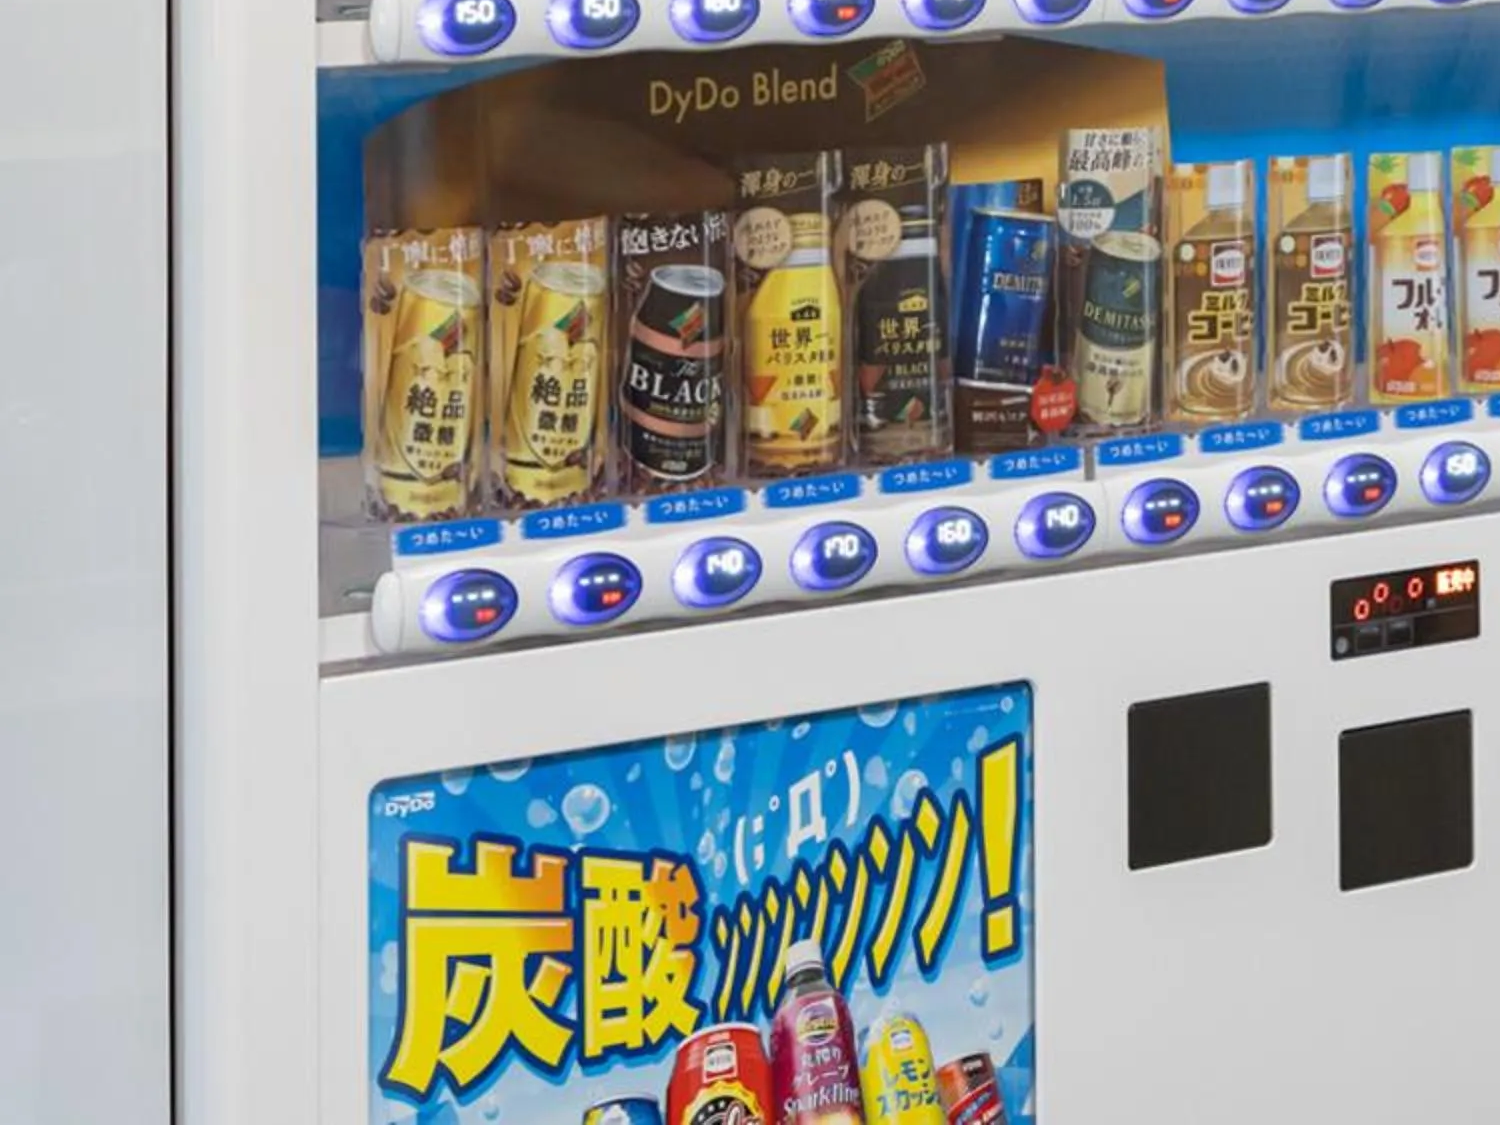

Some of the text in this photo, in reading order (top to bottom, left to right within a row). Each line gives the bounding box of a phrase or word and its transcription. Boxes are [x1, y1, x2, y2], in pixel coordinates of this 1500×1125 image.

[456, 0, 495, 24] 150
[650, 62, 838, 124] DyDo Blend
[825, 534, 858, 558] 170
[384, 790, 436, 818] DyDo
[386, 840, 701, 1095] 炭酸
